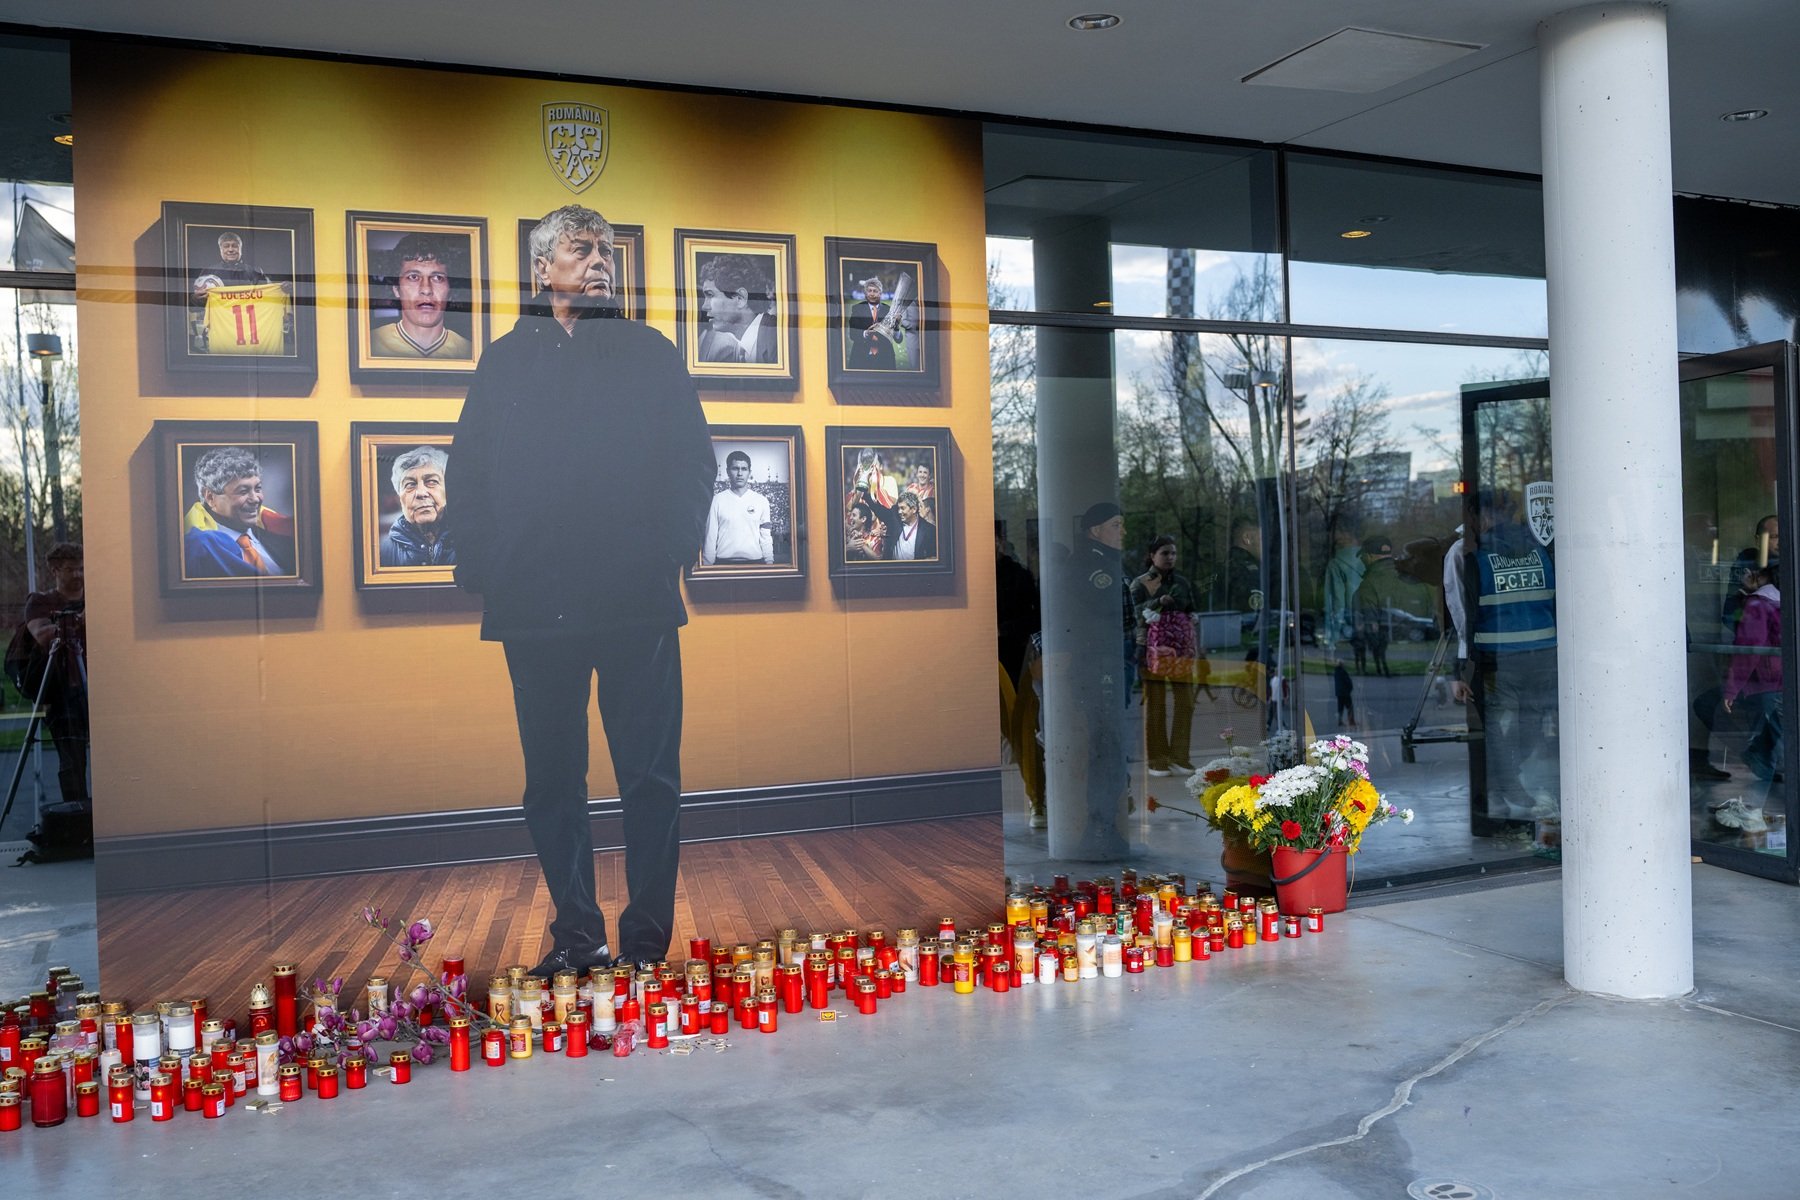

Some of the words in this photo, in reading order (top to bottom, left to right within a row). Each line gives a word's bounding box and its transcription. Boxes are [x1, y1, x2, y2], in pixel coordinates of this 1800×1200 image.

[549, 105, 601, 124] ROMÂNIA
[221, 290, 263, 299] LUCESCU
[232, 304, 259, 345] 11
[1496, 572, 1543, 590] P.C.F.A.
